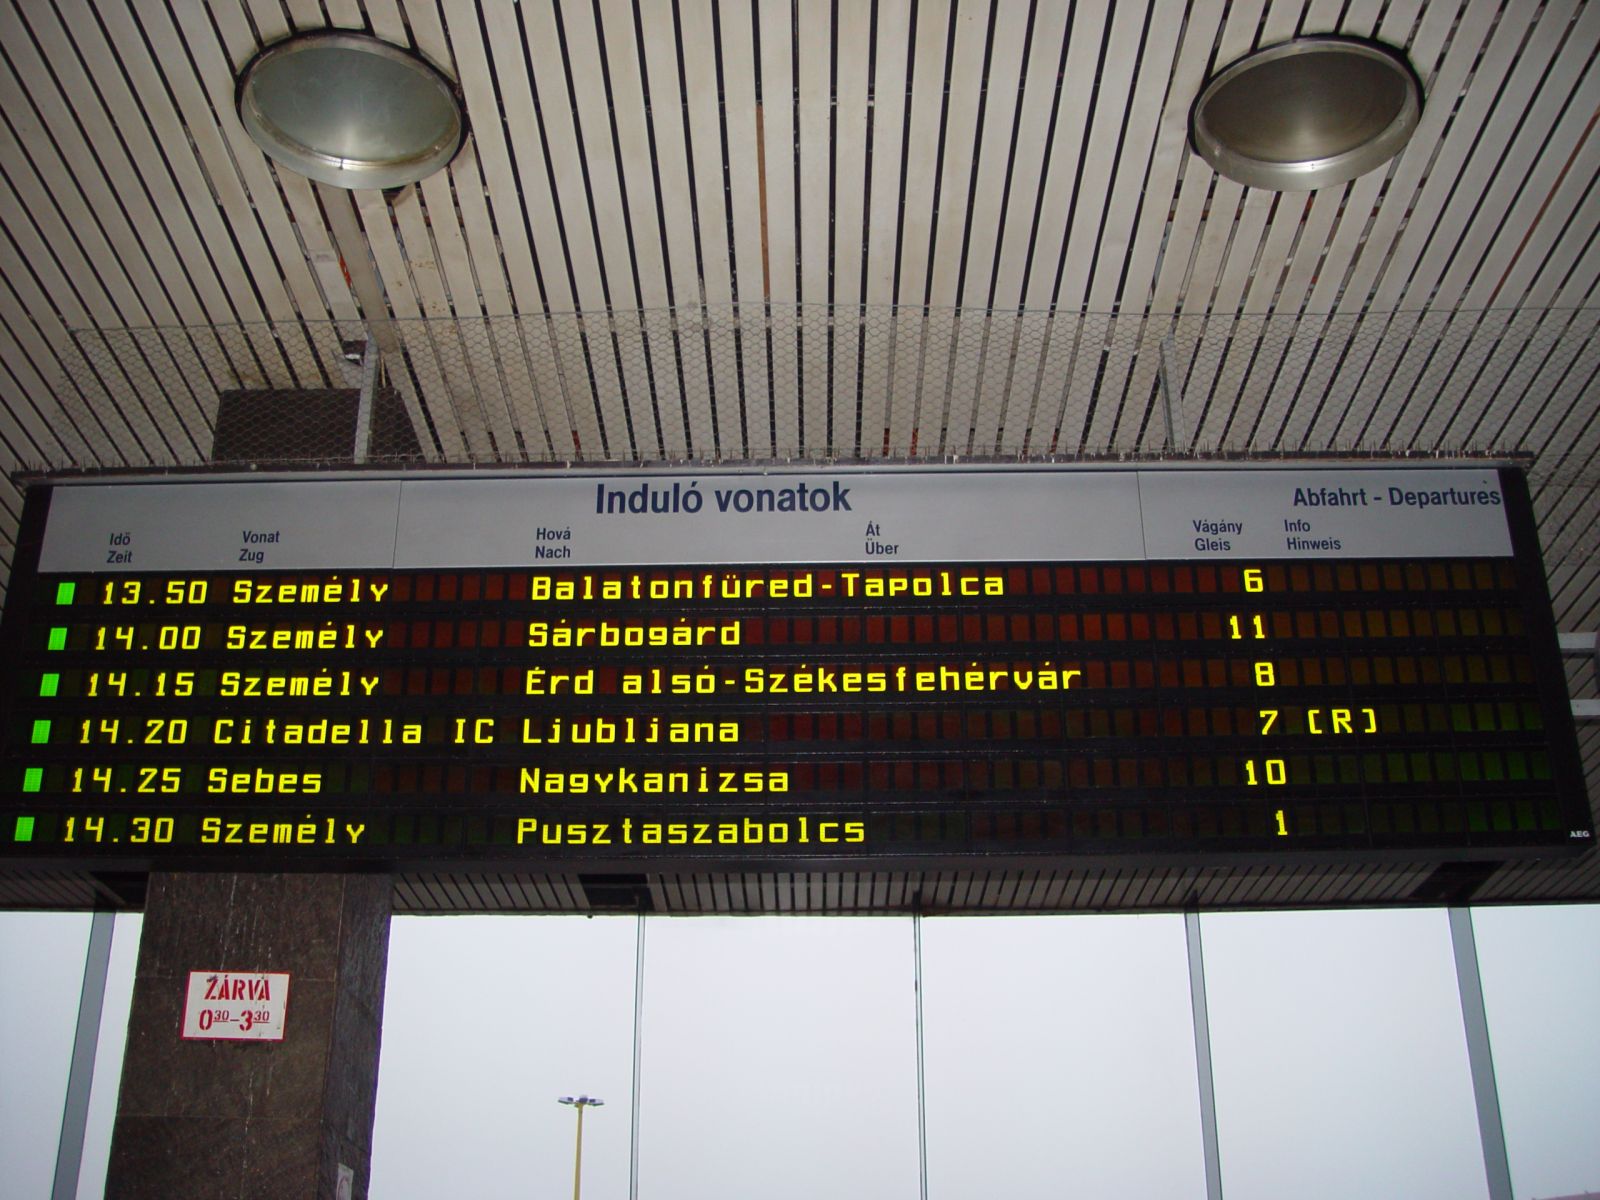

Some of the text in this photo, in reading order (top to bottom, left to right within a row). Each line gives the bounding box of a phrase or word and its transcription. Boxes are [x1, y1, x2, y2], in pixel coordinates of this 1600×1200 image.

[596, 481, 852, 514] Induló vonatok
[1293, 487, 1369, 507] Abfahrt
[1388, 487, 1501, 508] Departures
[535, 526, 571, 541] Hová
[865, 520, 881, 537] Át
[1192, 519, 1243, 535] Vágány
[1284, 519, 1311, 533] Info
[242, 530, 280, 544] Vonat
[1194, 538, 1232, 552] Gleis
[1286, 536, 1342, 551] Hinweis
[534, 545, 571, 559] Nach
[865, 537, 900, 555] Über
[106, 551, 133, 564] Zeit
[238, 549, 265, 564] Zug
[104, 570, 1263, 604] 13.50 Személy Balatonfüred-Tapolca 6
[96, 616, 1264, 649] 14.00 Személy Sárbogárd 11
[89, 662, 1274, 696] 14.15 Személy Érd alsó-Székesfehérvár 8
[81, 709, 1376, 743] 14.20 Citadella IC Ljubljana 7 [R]
[73, 760, 1285, 793] 14.25 Sebes Nagykanizsa 10
[65, 811, 1287, 843] 14.30 Személy Pusztaszabolcs 1
[1570, 830, 1590, 838] AEG
